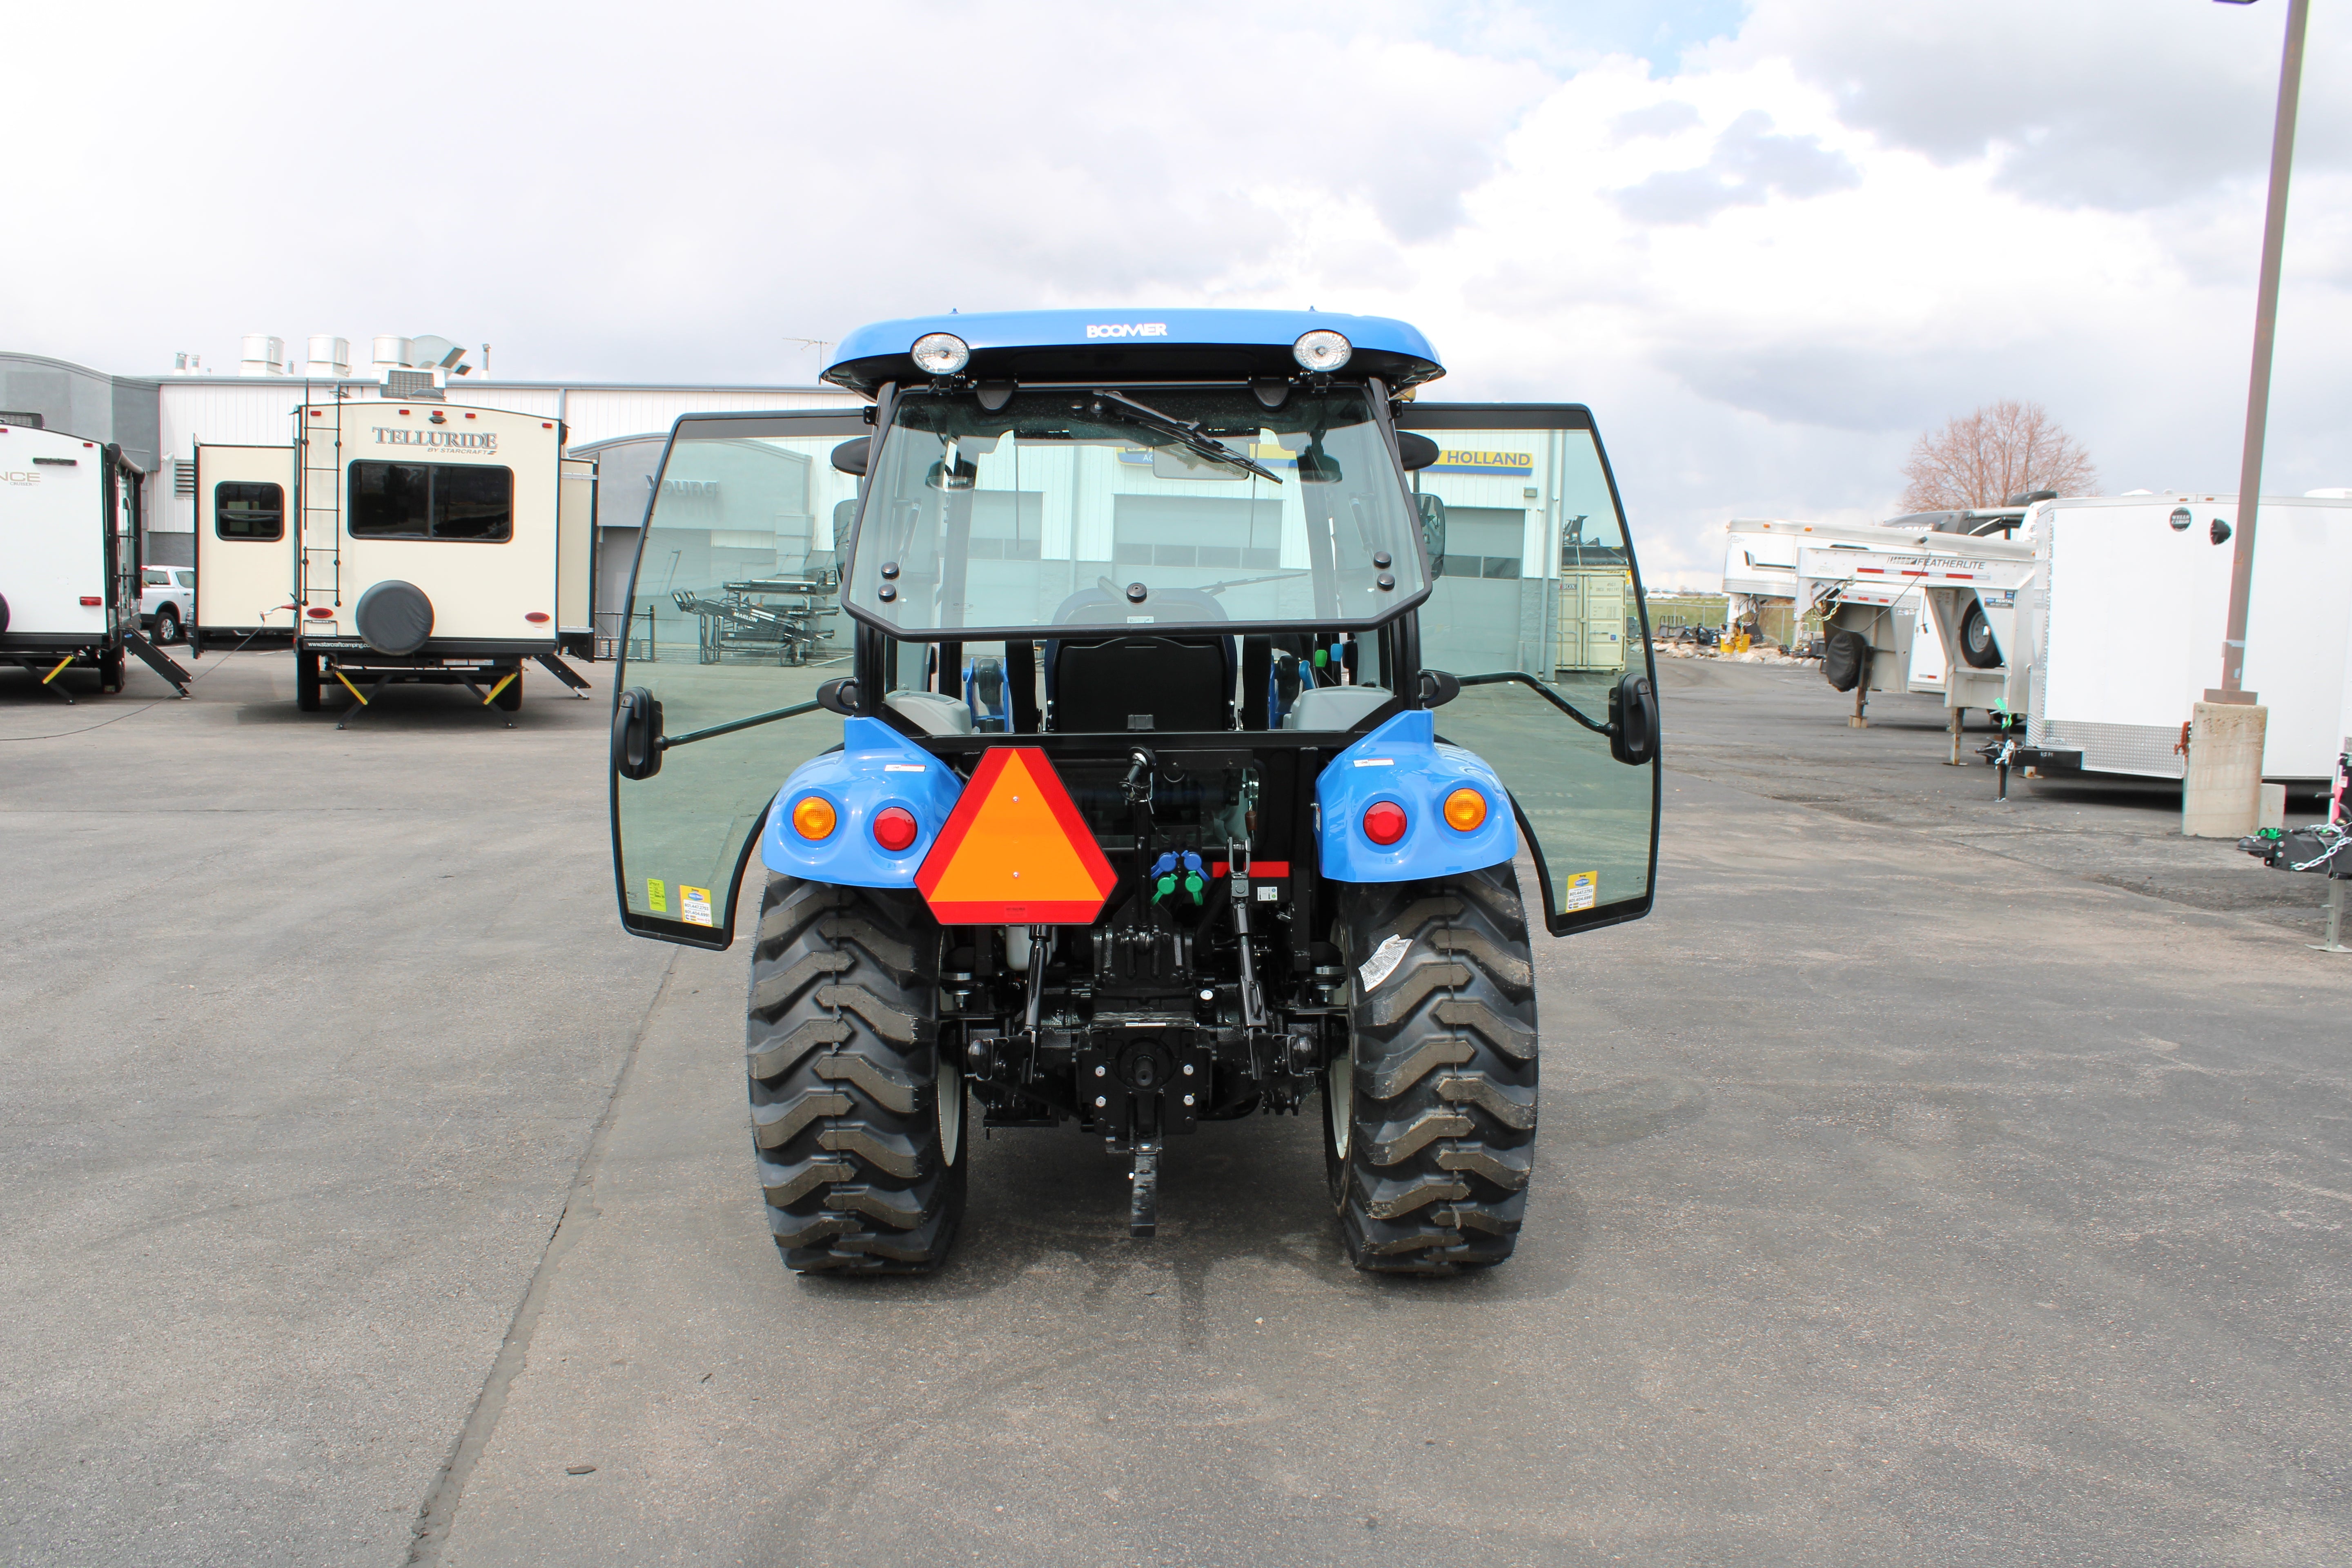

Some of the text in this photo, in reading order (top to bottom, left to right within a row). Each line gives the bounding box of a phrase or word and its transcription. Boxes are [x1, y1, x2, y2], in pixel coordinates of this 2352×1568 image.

[1087, 323, 1168, 339] BOOMER
[372, 426, 498, 450] TELLURIDE
[1447, 451, 1530, 466] HOLLAND
[1917, 557, 1986, 570] FEATHERLITE
[733, 612, 758, 623] MARLON
